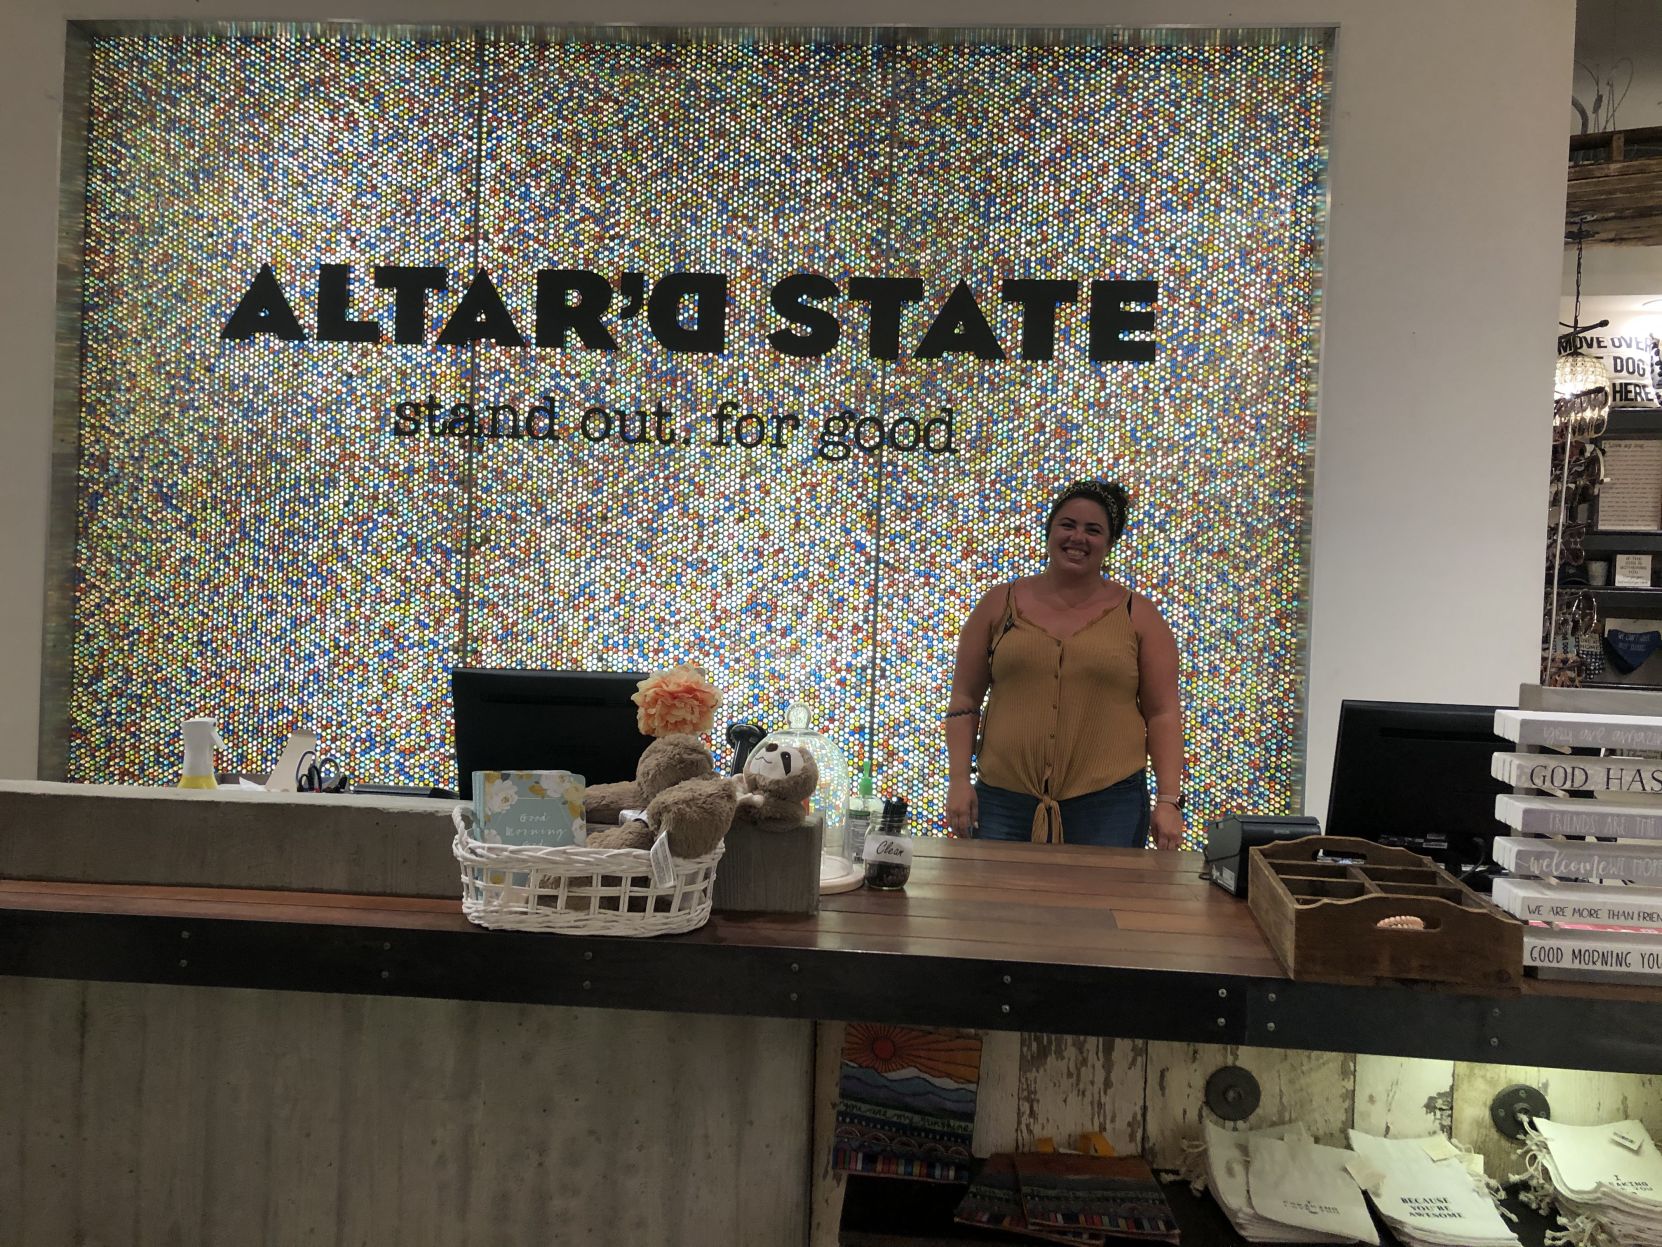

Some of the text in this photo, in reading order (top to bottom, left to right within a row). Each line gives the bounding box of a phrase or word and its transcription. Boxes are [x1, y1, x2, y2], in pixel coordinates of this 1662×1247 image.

[766, 273, 1158, 362] STATE
[1610, 336, 1653, 352] OVER
[1613, 356, 1646, 377] DOG
[1612, 382, 1654, 402] HERE
[394, 393, 958, 461] stand out. for good
[1530, 765, 1662, 792] GOD HAS
[519, 812, 546, 822] Good
[1549, 813, 1597, 832] FRIENDS
[1604, 815, 1626, 835] ARE
[876, 840, 905, 857] Clean
[1528, 850, 1607, 878] welcome
[1527, 904, 1544, 915] WE
[1550, 906, 1568, 917] ARE
[1572, 907, 1602, 919] MORE
[1607, 909, 1635, 921] THAN
[1530, 946, 1662, 970] GOOD MORNING YOU
[1400, 1196, 1450, 1205] BECAUSE
[1408, 1211, 1465, 1219] AWESOME
